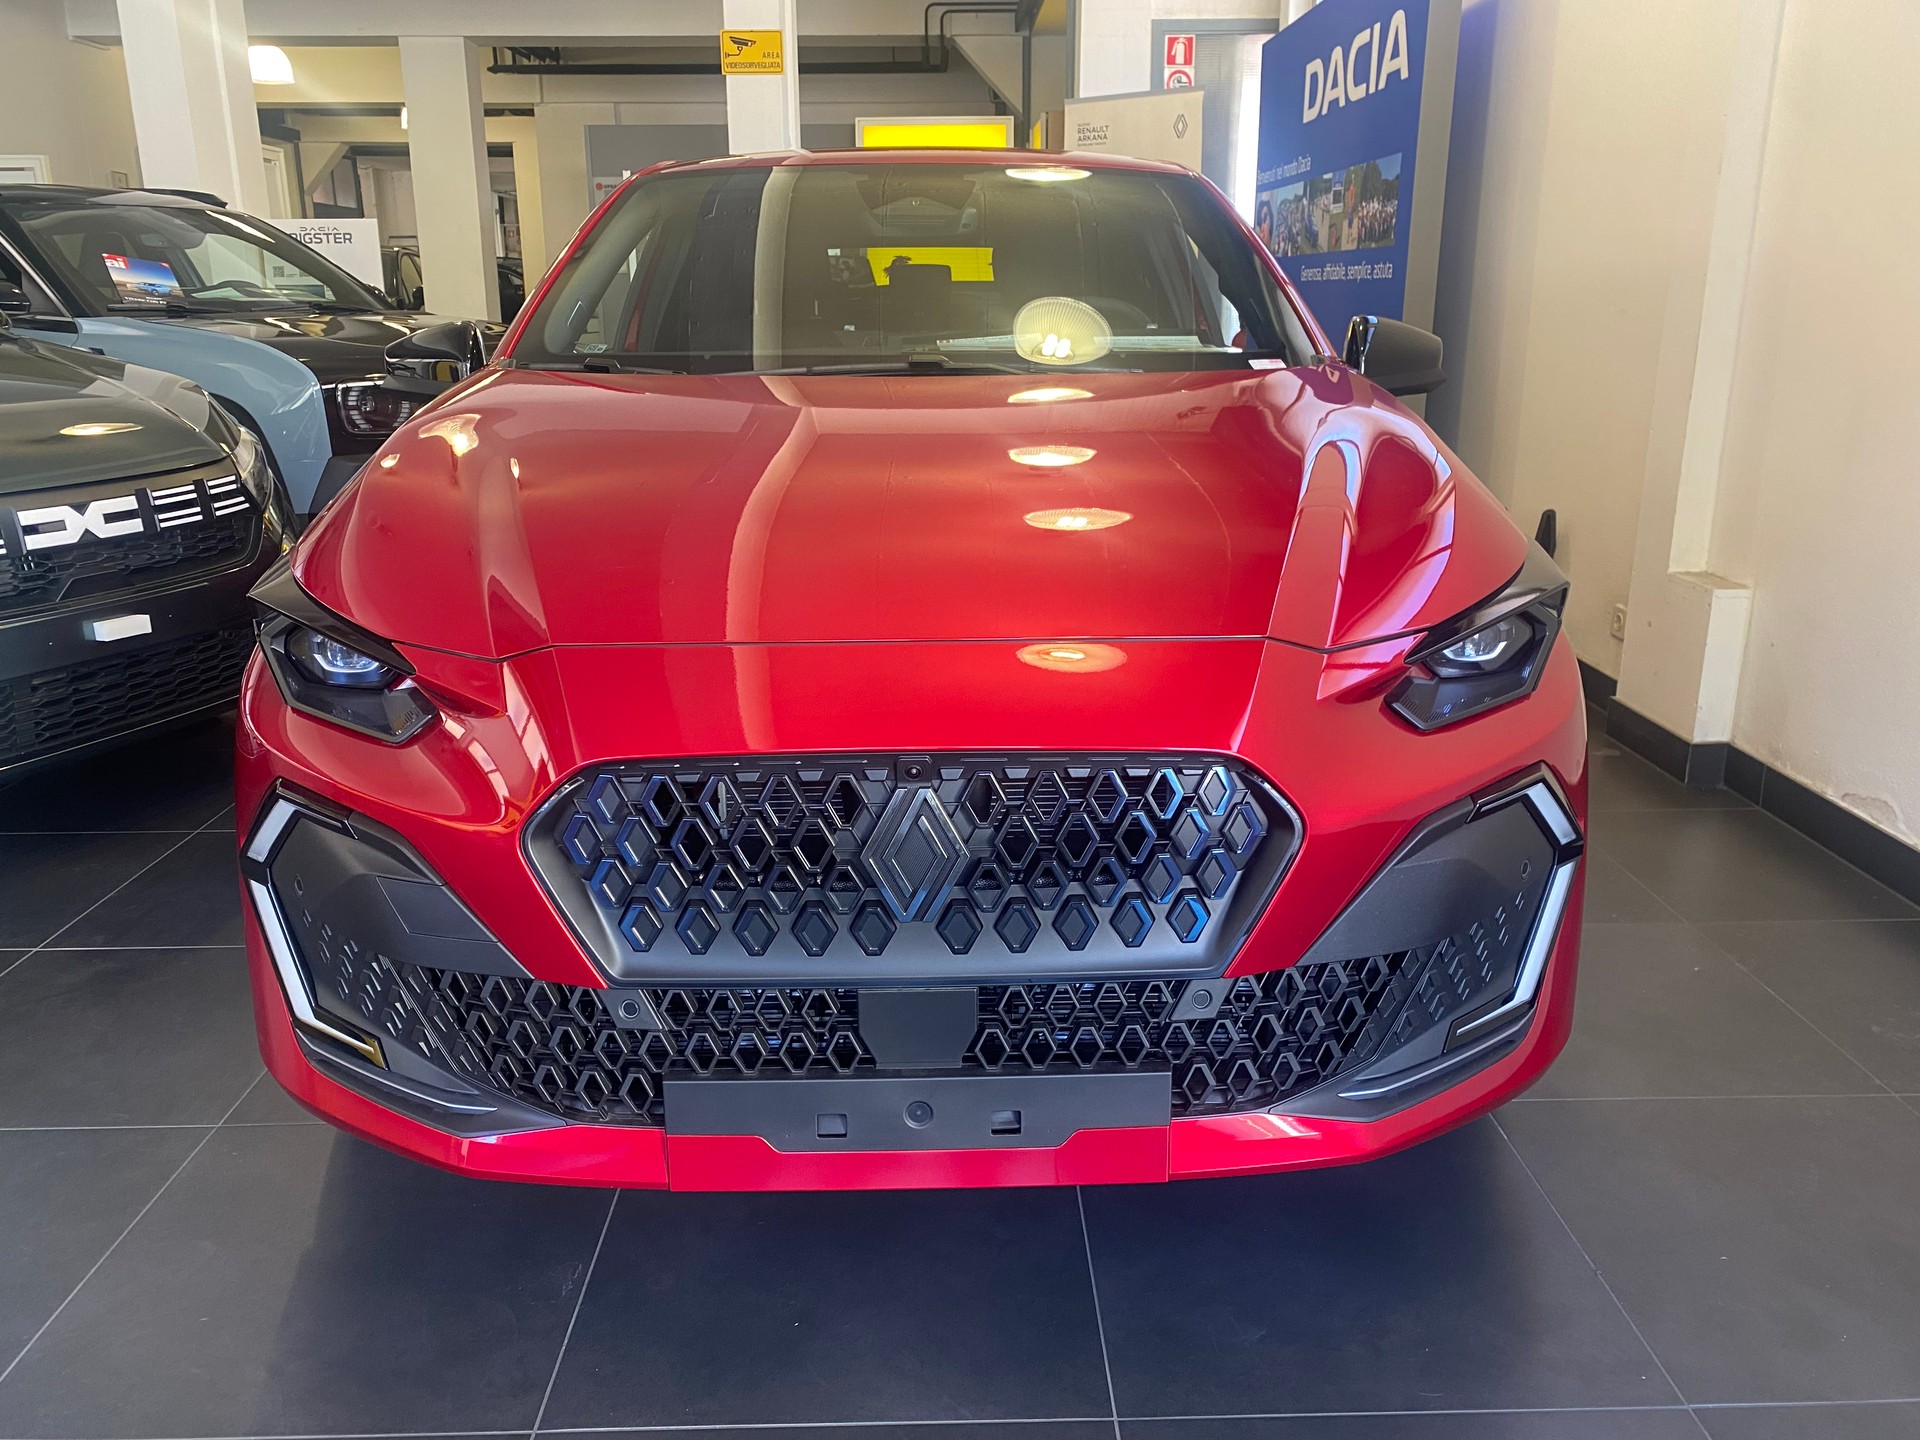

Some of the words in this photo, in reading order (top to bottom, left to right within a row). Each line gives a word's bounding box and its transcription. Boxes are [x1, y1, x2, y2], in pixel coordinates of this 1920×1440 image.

[762, 51, 780, 59] AREA
[725, 61, 781, 69] VIDEOSORVEGLIATA
[1303, 9, 1409, 124] DACIA
[1077, 125, 1109, 134] RENAULT
[1077, 133, 1108, 141] ARKANA
[1298, 153, 1311, 173] Dacia
[1347, 261, 1372, 283] semplice,
[1372, 261, 1393, 279] astuta
